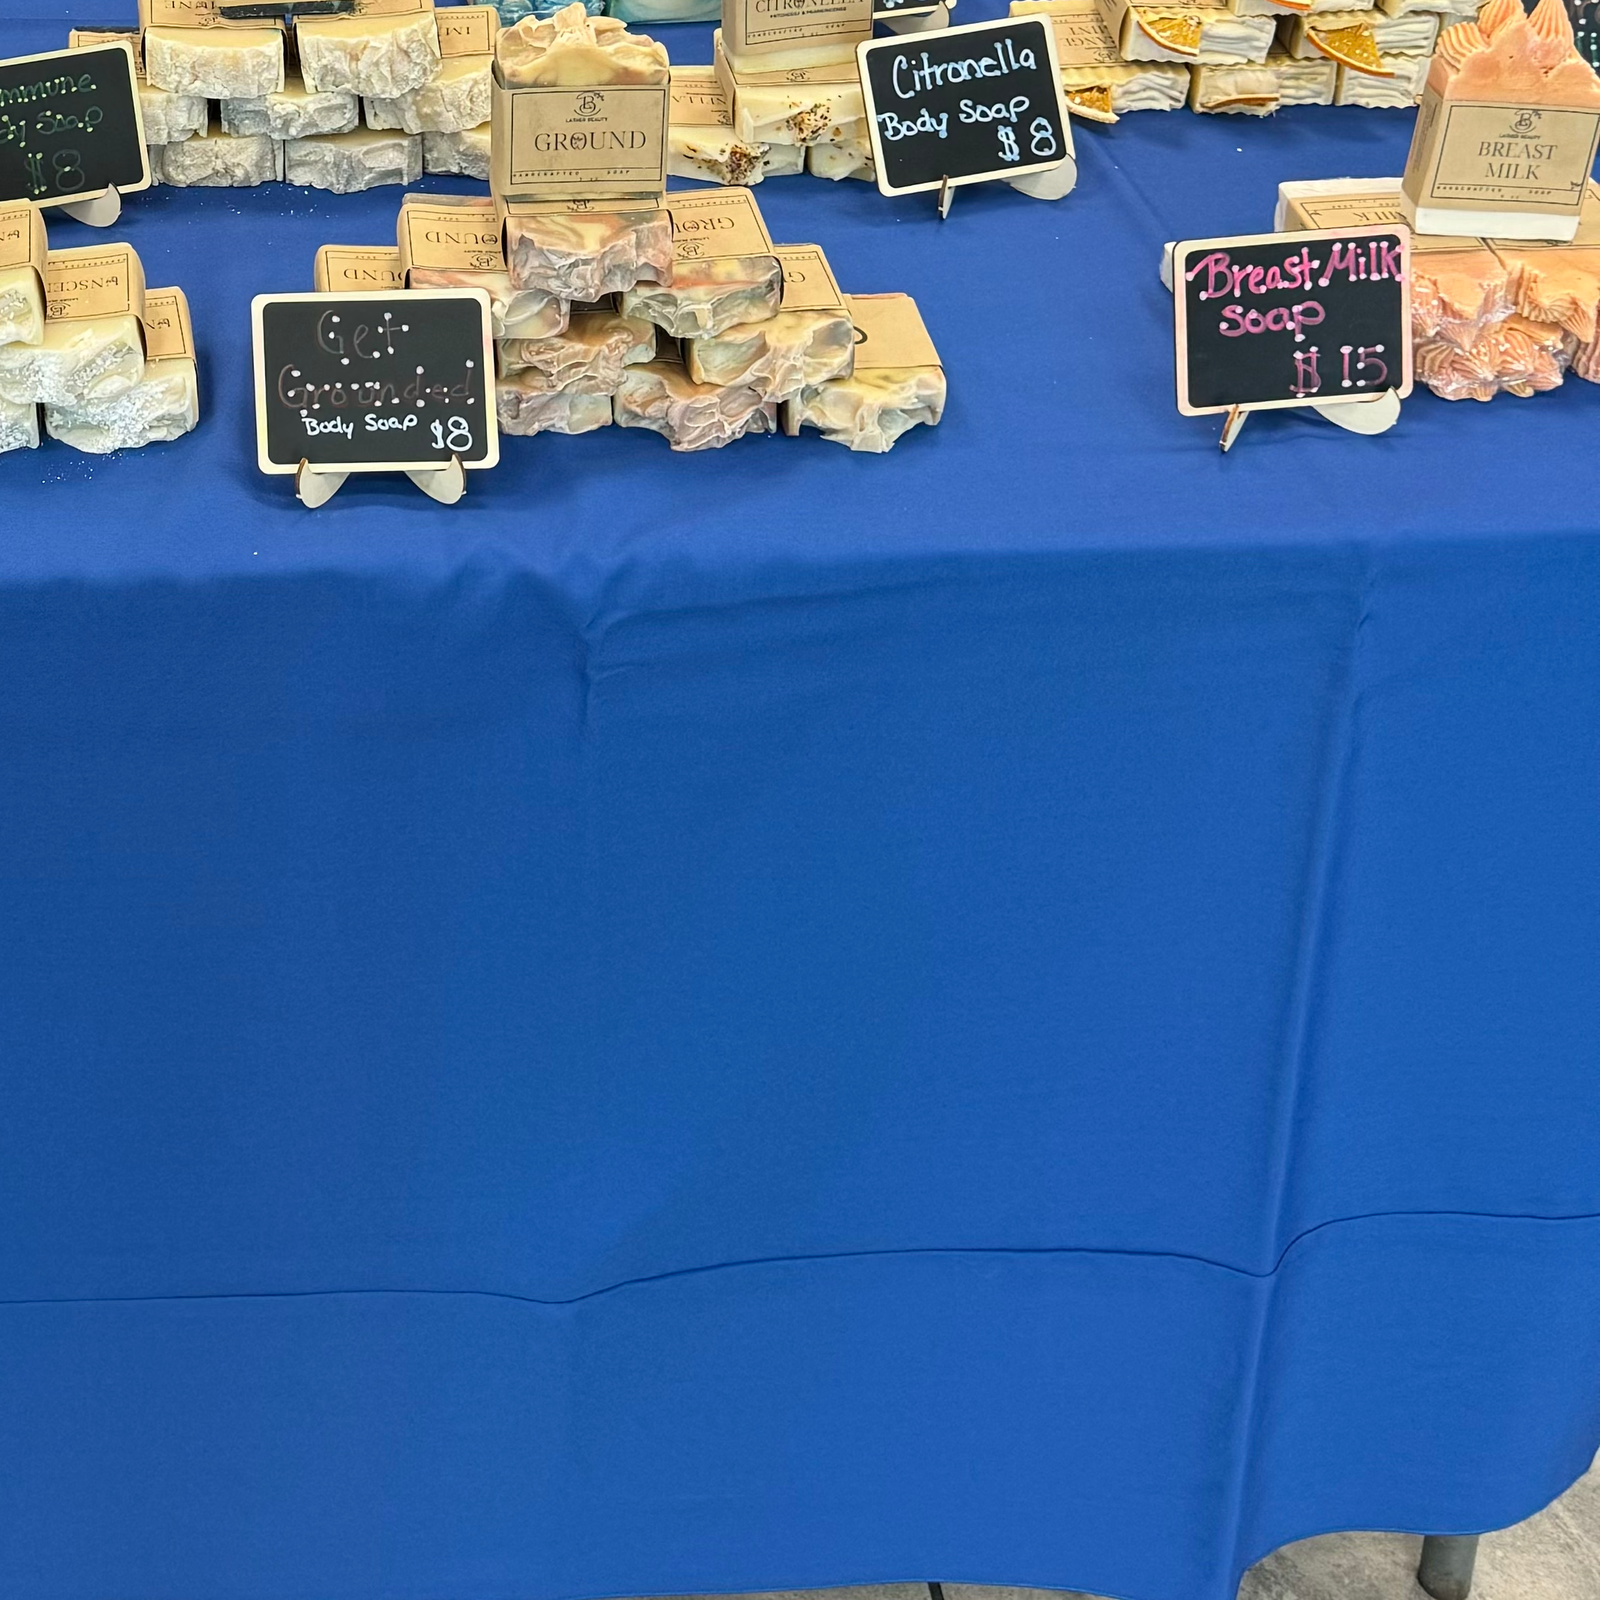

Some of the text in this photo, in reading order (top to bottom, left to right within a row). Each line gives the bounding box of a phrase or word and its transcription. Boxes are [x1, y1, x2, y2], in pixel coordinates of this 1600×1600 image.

[892, 38, 1037, 99] Citronella
[534, 130, 647, 151] GROUND
[876, 107, 948, 141] Body
[997, 116, 1056, 162] $8
[25, 148, 86, 195] $8
[1478, 141, 1558, 160] BREAST
[1485, 162, 1542, 181] MILK
[1185, 240, 1406, 300] Breast Milk
[317, 309, 410, 366] Get
[278, 359, 475, 417] Grounded
[1289, 344, 1389, 398] $15
[302, 416, 354, 439] Body
[430, 416, 473, 452] $8
